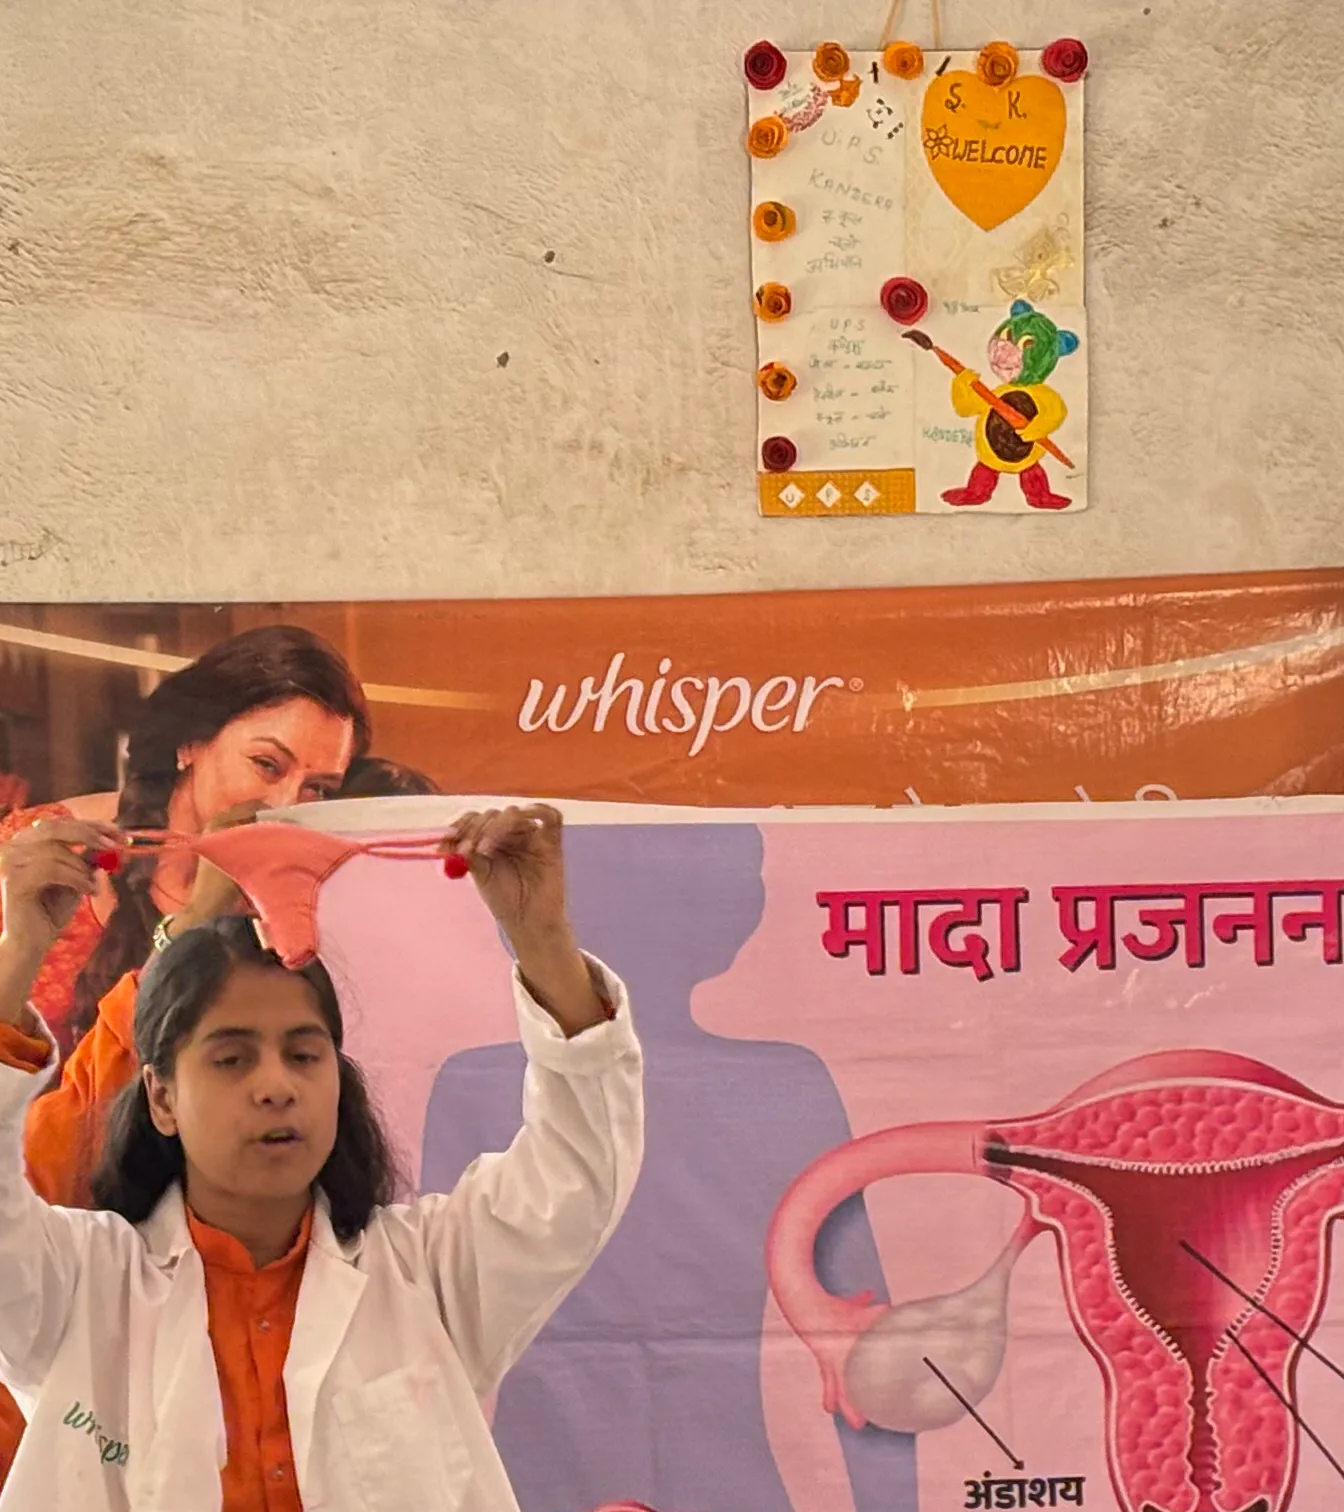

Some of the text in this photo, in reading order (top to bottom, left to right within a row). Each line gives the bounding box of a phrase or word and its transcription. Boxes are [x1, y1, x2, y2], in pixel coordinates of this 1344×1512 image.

[951, 137, 1047, 169] WELCOME
[518, 652, 845, 757] whisper
[816, 887, 1029, 982] मादा
[964, 1470, 1086, 1510] अंडाशय
